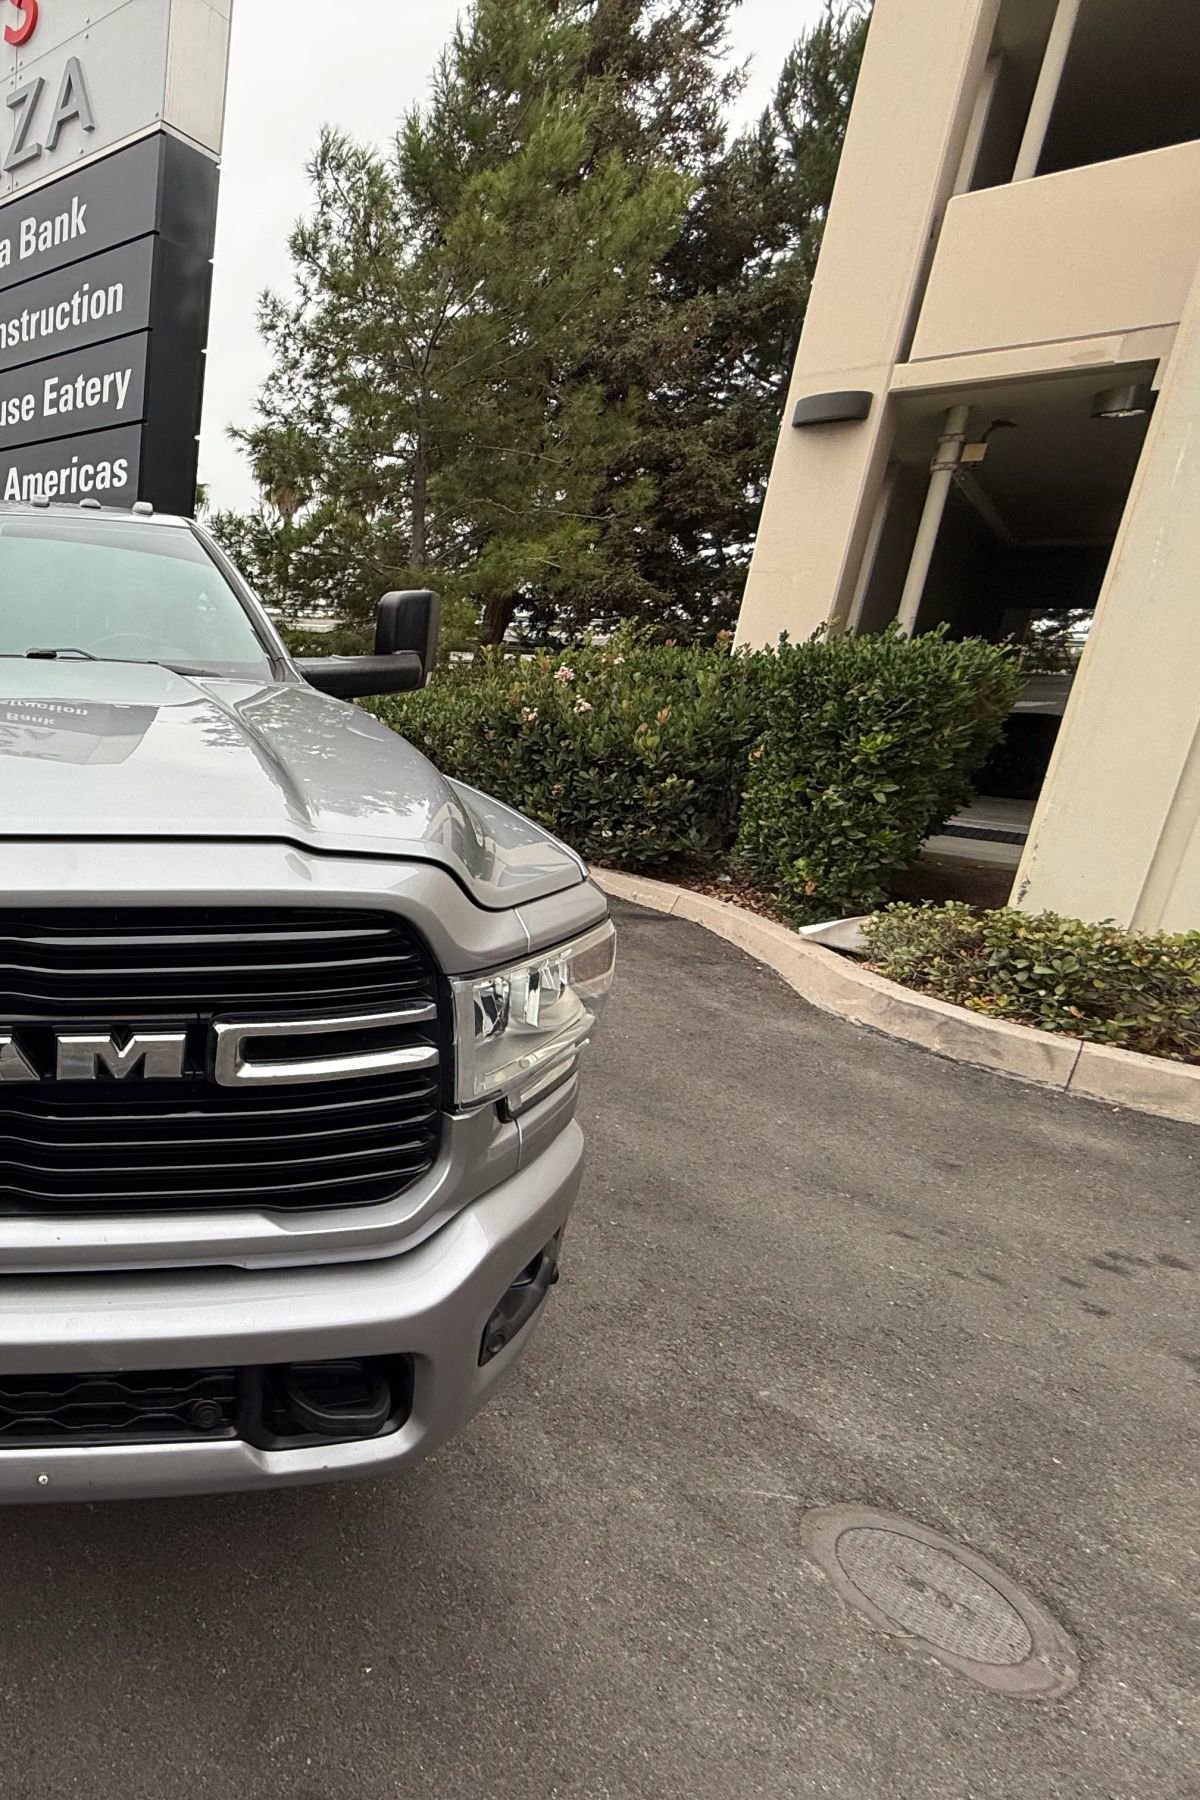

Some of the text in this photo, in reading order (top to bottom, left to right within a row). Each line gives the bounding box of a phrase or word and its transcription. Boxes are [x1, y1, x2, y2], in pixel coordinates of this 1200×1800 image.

[19, 196, 87, 260] Bank
[42, 368, 132, 418] Eatery
[4, 456, 128, 500] Americas
